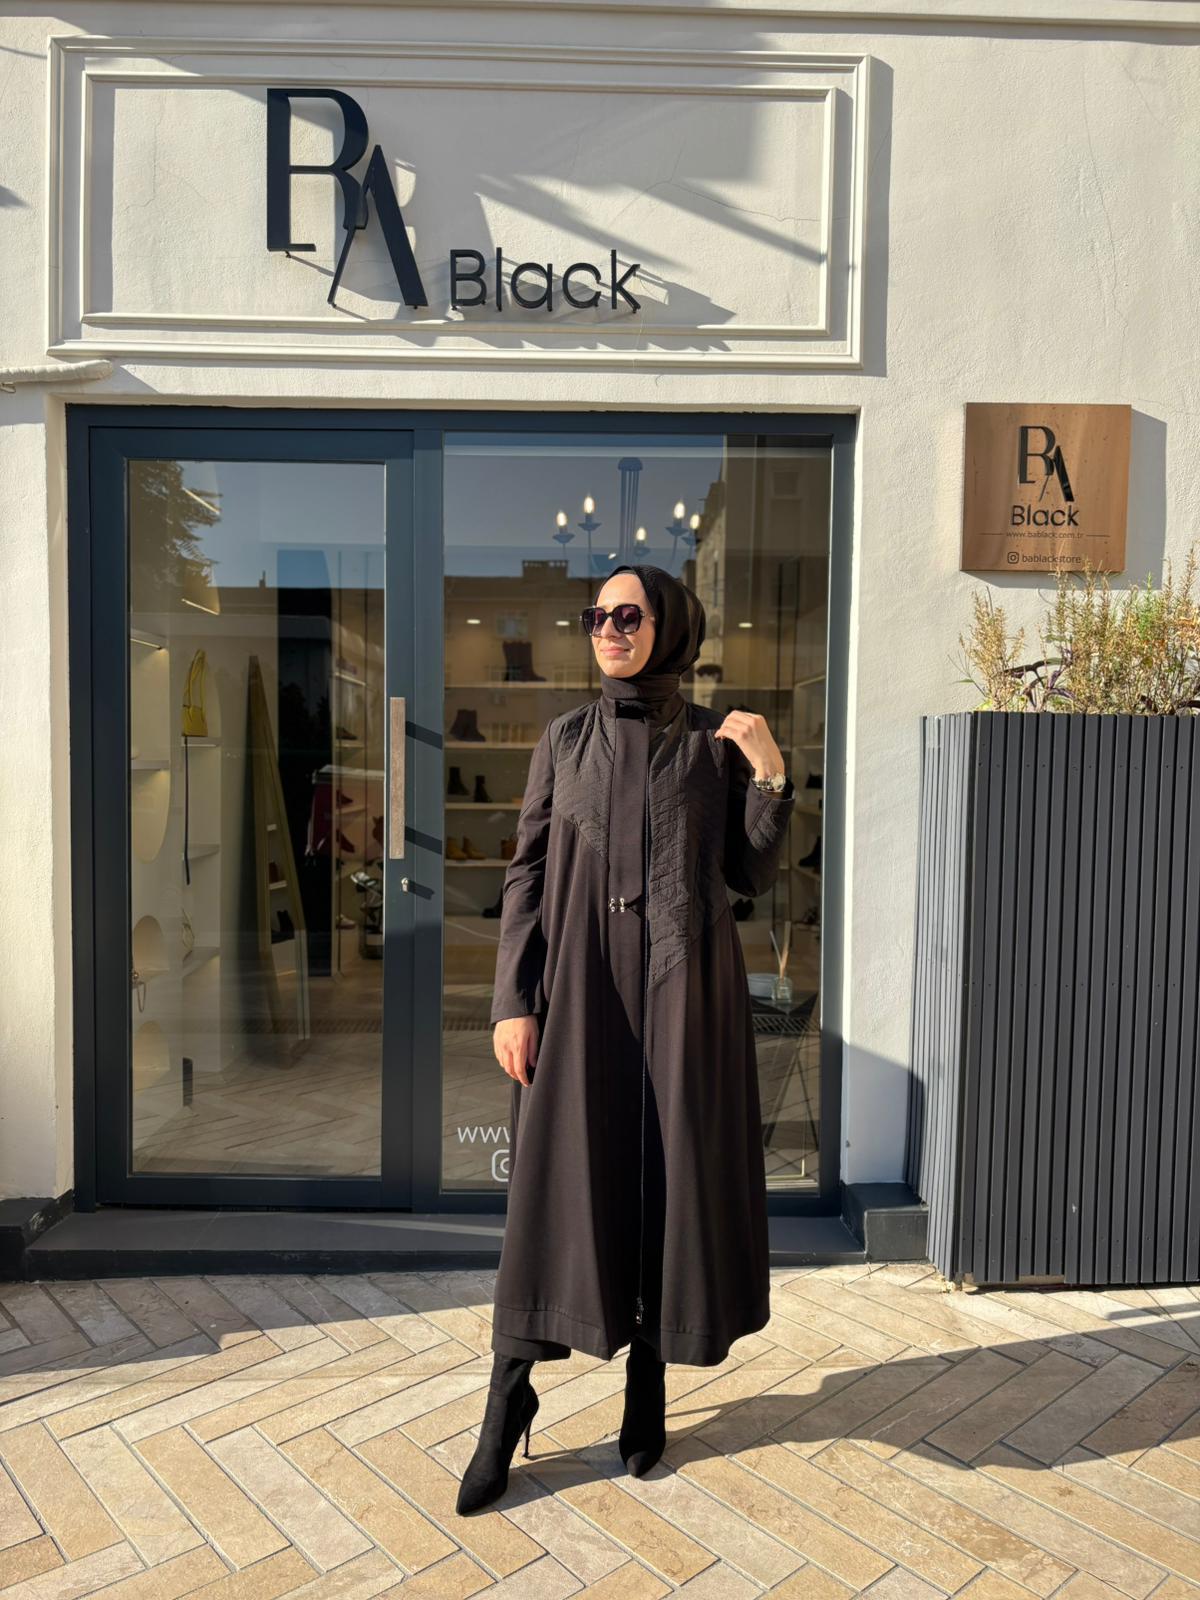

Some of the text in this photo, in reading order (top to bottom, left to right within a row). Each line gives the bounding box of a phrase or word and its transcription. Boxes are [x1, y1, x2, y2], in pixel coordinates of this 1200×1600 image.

[450, 247, 641, 312] Black
[1011, 504, 1080, 526] Black
[1006, 530, 1084, 539] www.bablack.com.tr
[1022, 553, 1081, 564] bablackstore
